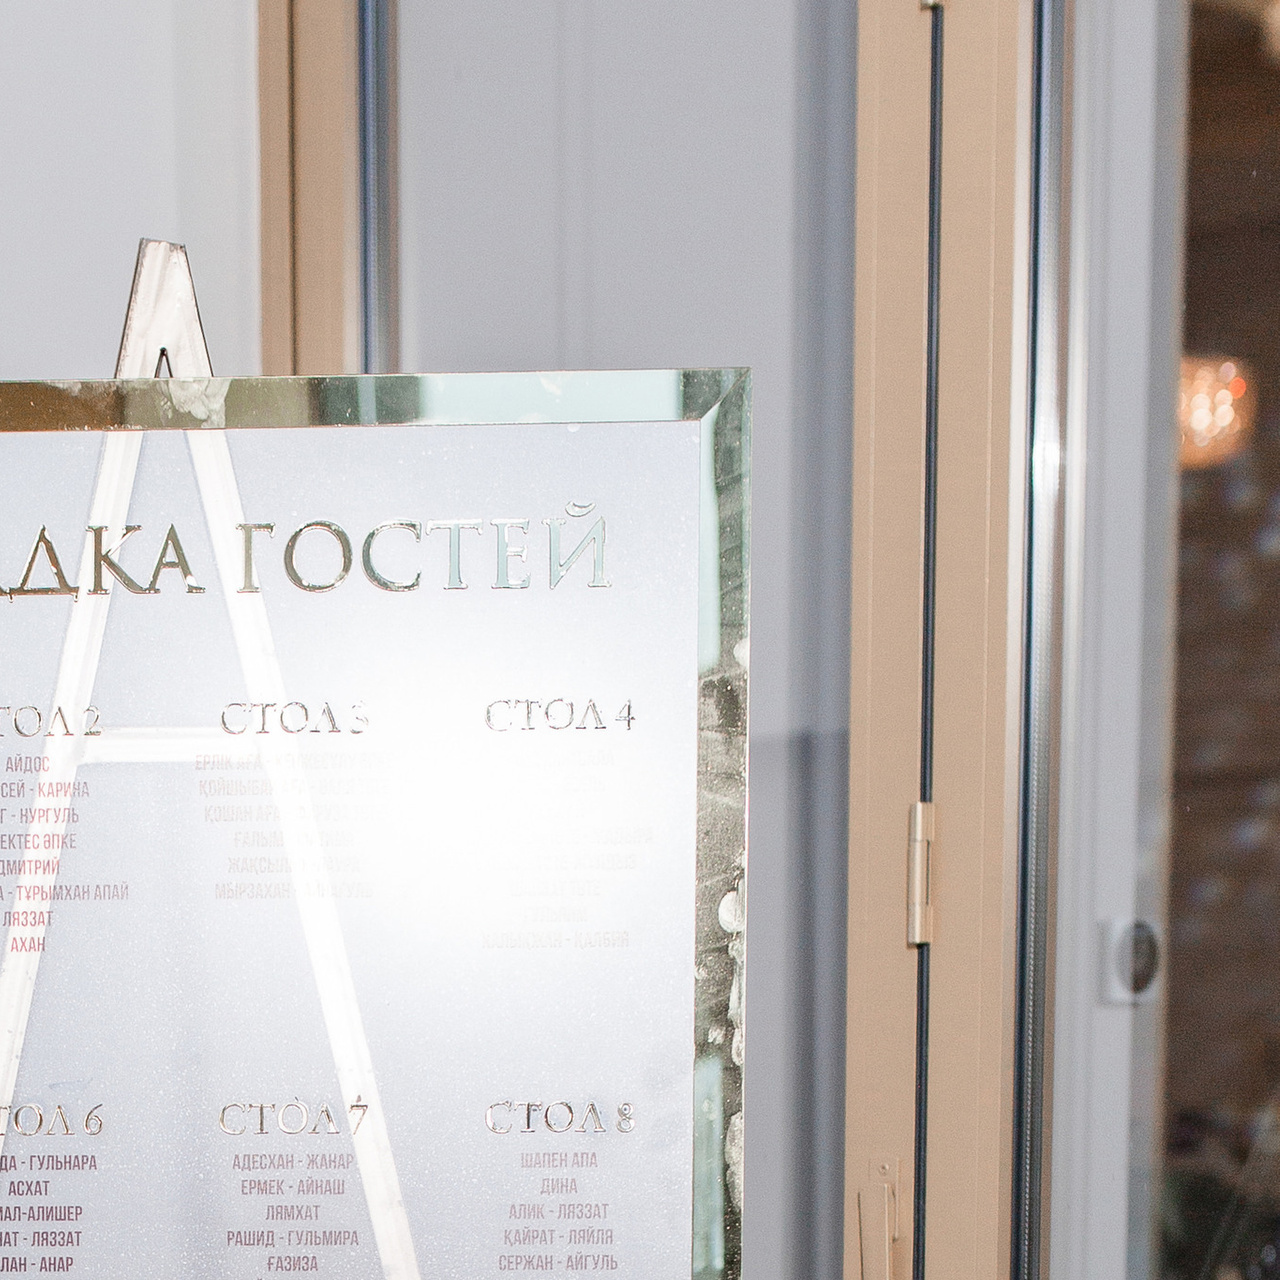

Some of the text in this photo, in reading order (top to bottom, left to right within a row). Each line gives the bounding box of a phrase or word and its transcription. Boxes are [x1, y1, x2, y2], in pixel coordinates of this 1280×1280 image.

[235, 500, 612, 593] ГОСТЕЙ
[83, 706, 103, 738] 2
[485, 698, 636, 732] СТОЛ 4
[84, 1103, 104, 1137] 6
[219, 1102, 368, 1135] СТОЛ 7
[485, 1101, 636, 1134] СТОЛ 8
[30, 1155, 97, 1170] ГУЛЬНАРА
[8, 1181, 49, 1196] АСХАТ
[31, 1231, 82, 1246] ЛЯЗЗАТ
[40, 1257, 73, 1272] АНАР
